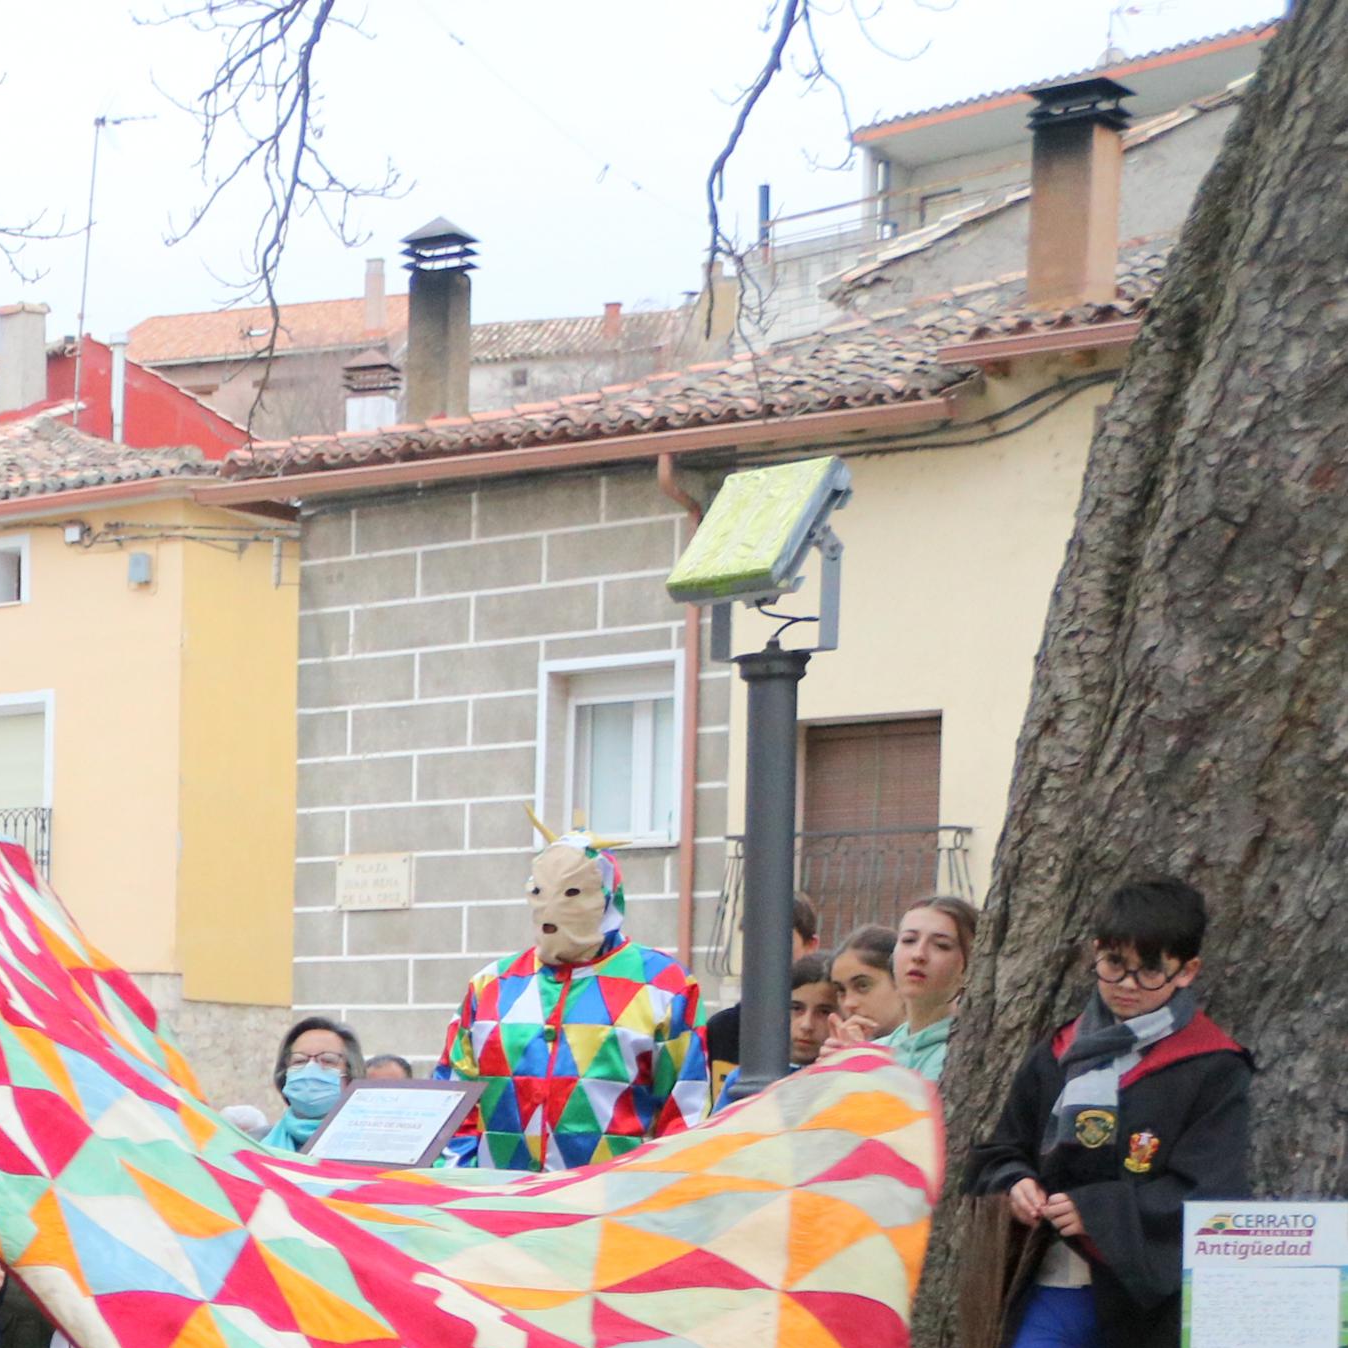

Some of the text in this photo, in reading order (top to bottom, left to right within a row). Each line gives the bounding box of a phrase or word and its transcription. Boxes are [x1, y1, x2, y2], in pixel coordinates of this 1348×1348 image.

[355, 863, 388, 873] PLAZA
[1232, 1214, 1317, 1228] CERRATO
[1195, 1240, 1312, 1260] Antigüedad
